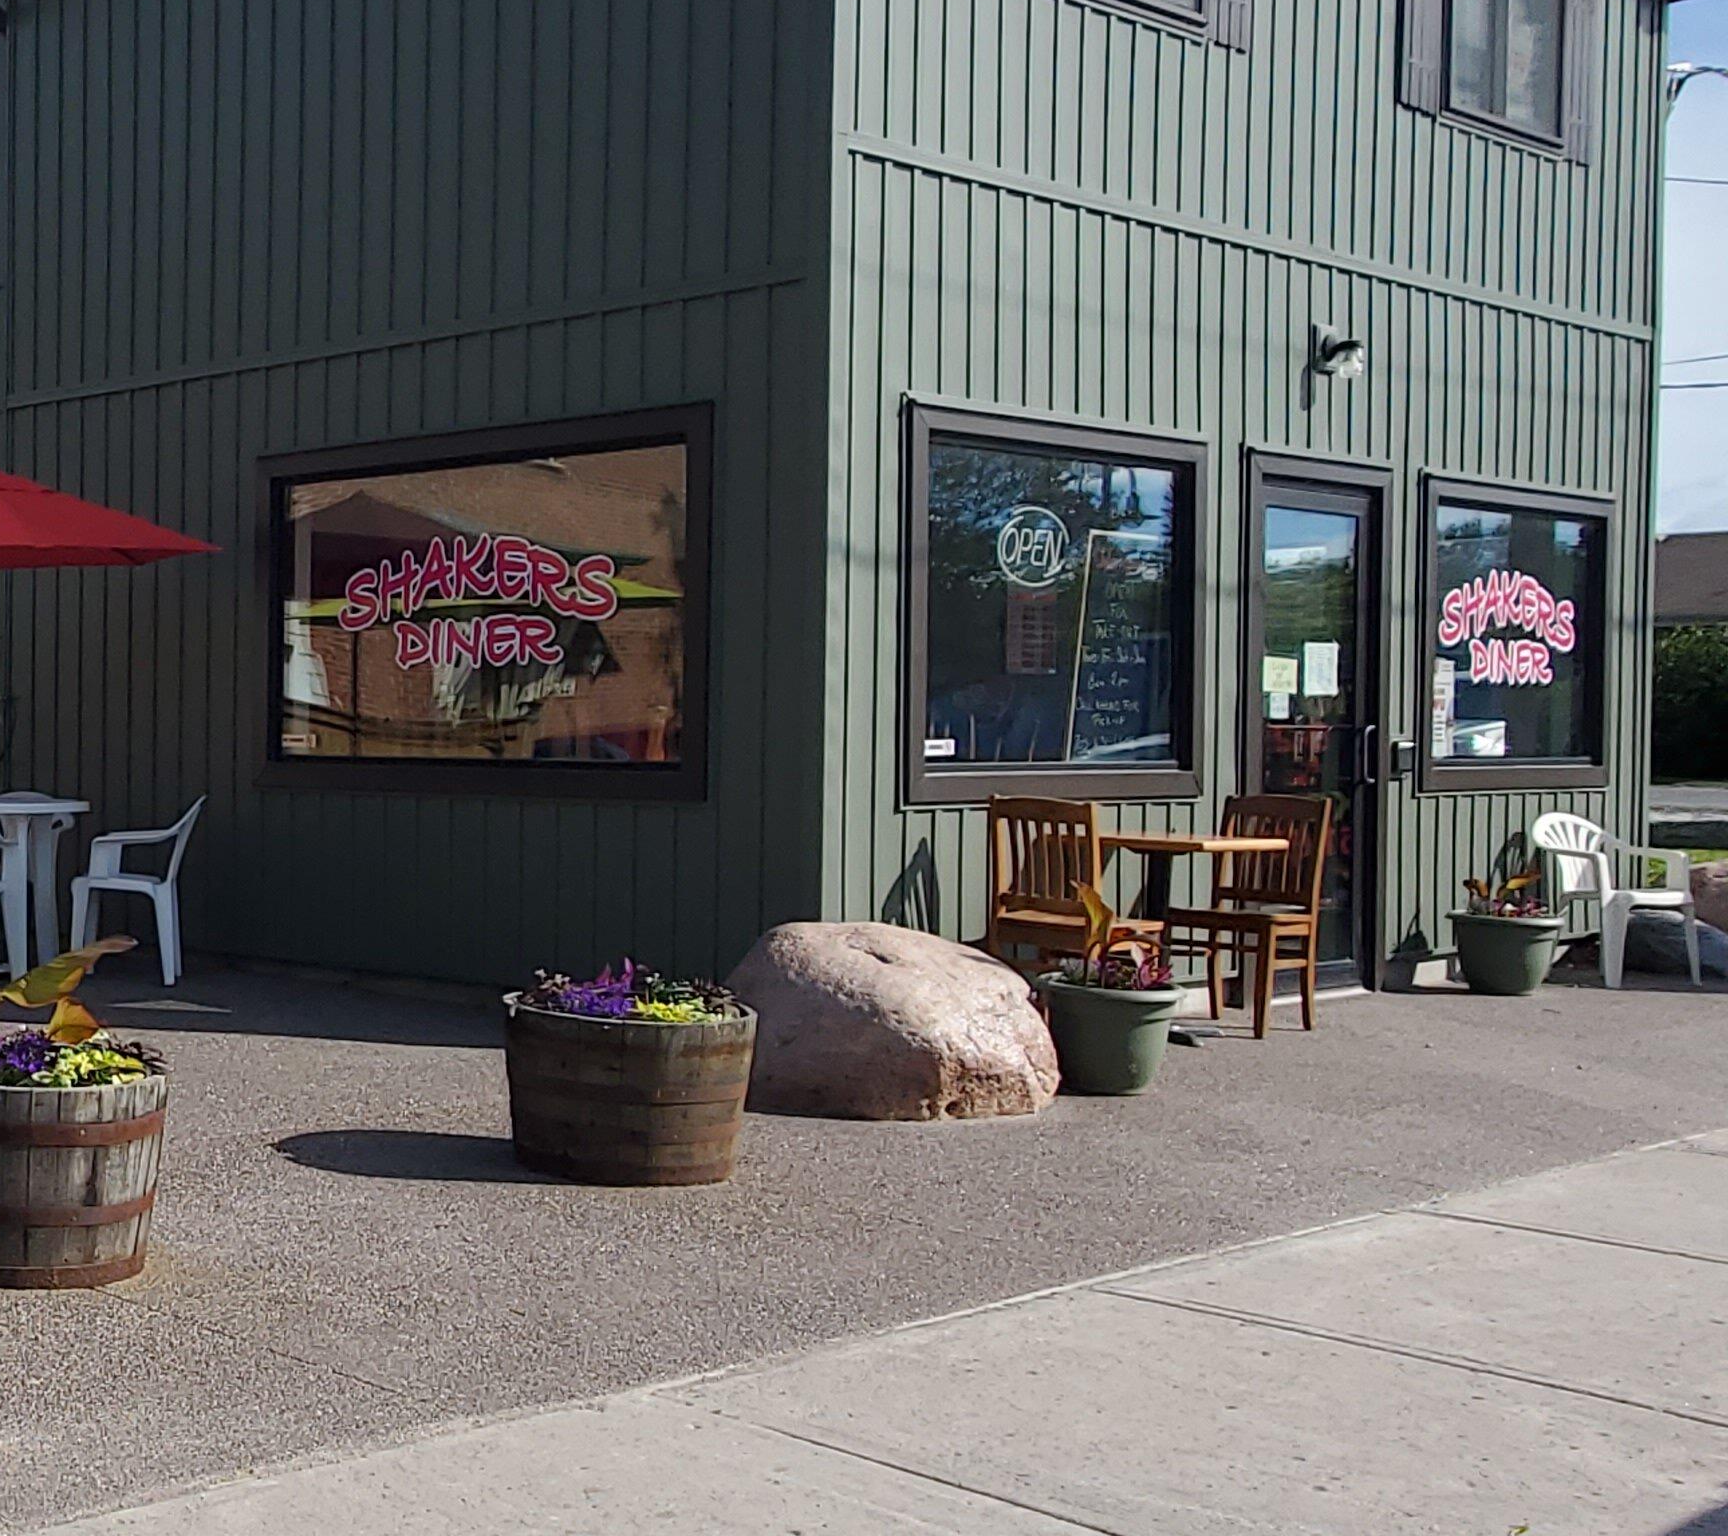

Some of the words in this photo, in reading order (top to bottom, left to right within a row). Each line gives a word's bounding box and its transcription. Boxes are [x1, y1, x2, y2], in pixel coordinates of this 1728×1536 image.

[1002, 528, 1063, 568] OPEN
[340, 534, 617, 631] SHAKERS
[1439, 569, 1575, 652] SHAKERS
[394, 615, 563, 669] DINER
[1470, 639, 1553, 685] DINER
